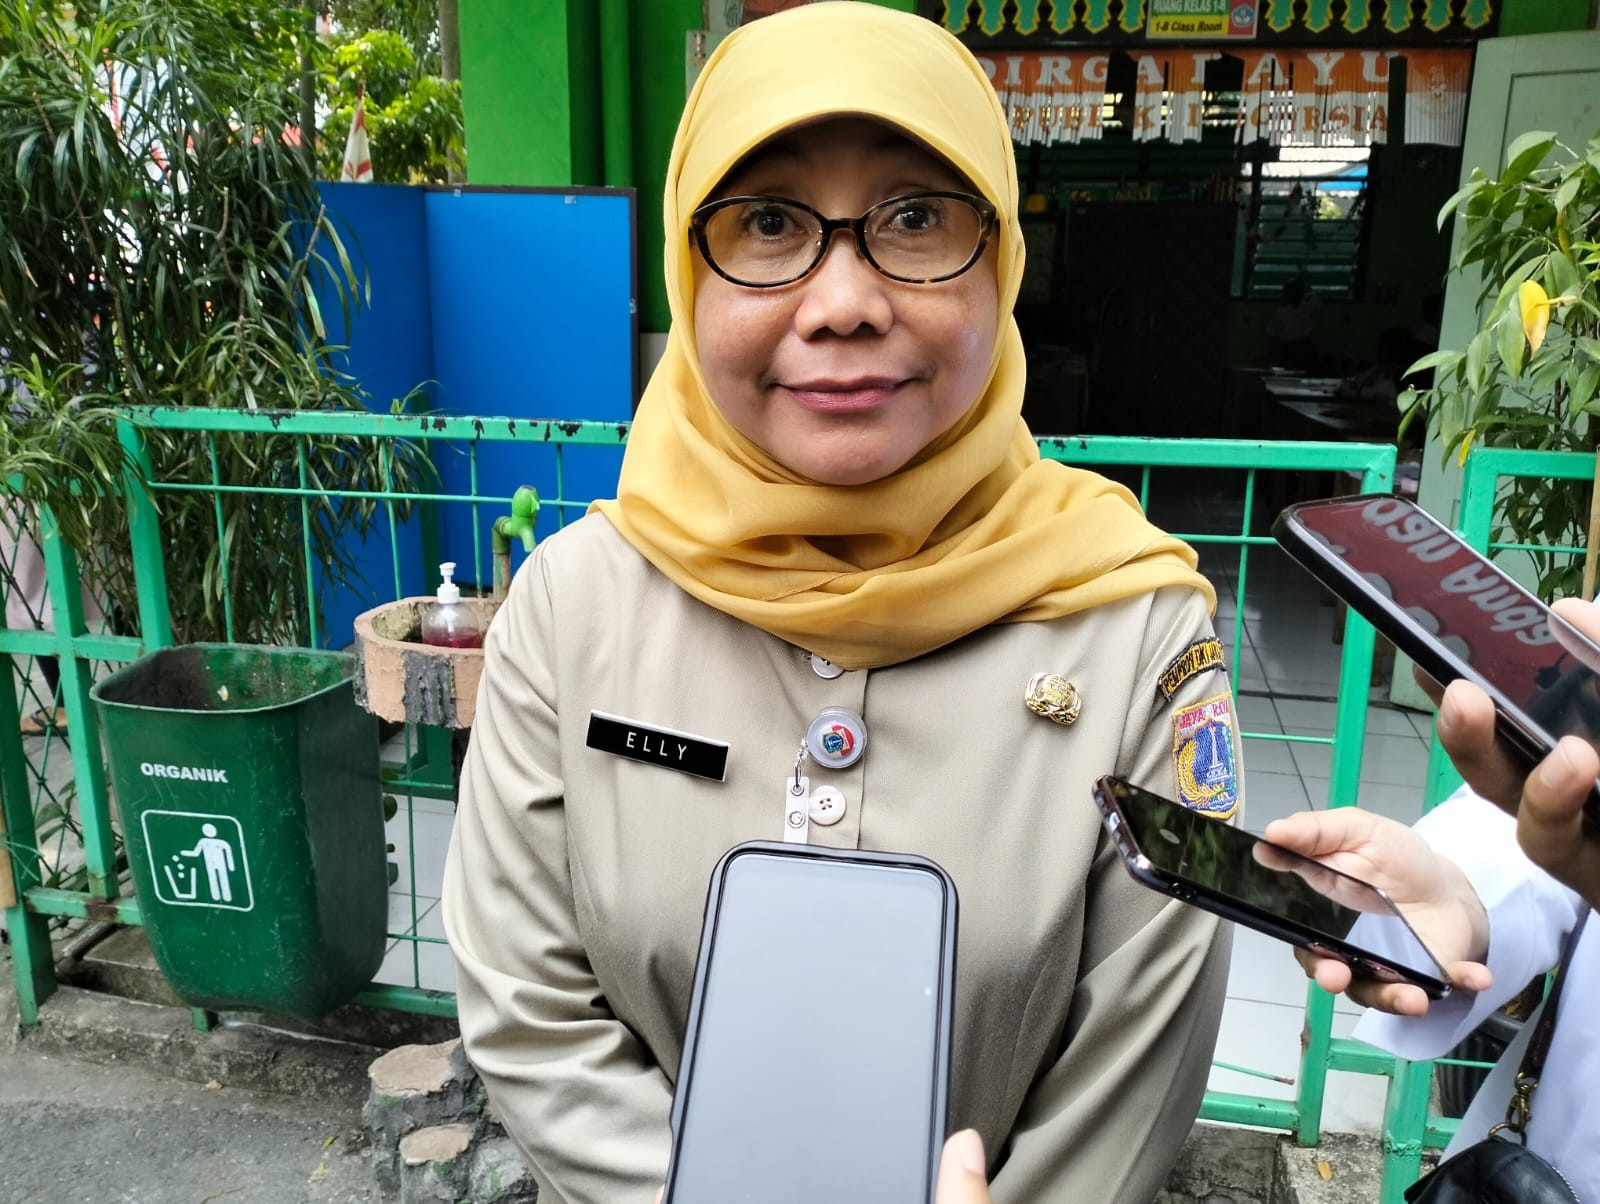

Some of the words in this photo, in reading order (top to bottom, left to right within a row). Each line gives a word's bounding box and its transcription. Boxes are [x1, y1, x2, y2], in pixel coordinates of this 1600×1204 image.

[1171, 20, 1195, 32] Class
[1197, 20, 1223, 32] Room
[1180, 709, 1205, 728] JAYA
[626, 731, 687, 760] ELLY
[140, 762, 228, 783] ORGANIK
